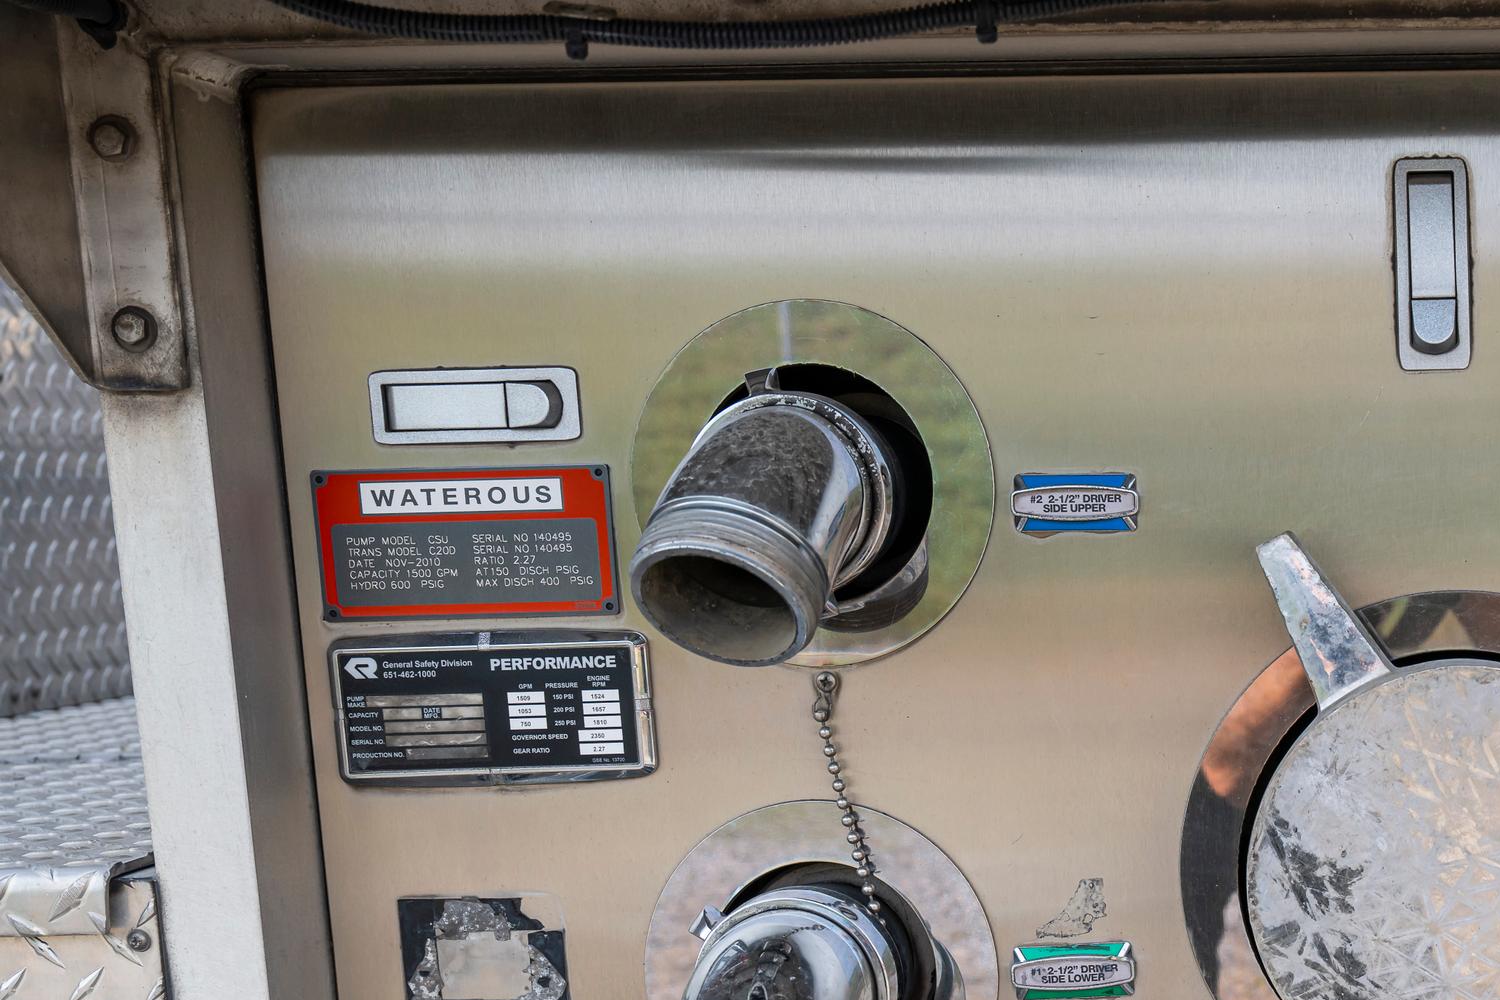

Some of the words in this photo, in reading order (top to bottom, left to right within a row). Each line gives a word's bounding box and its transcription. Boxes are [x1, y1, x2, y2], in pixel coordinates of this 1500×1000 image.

[370, 485, 552, 507] WATEROUS
[1030, 495, 1043, 503] #2
[1082, 494, 1122, 503] DRIVER
[1043, 504, 1068, 513] SIDE
[1070, 504, 1106, 513] UPPER
[346, 536, 376, 546] PUMP
[381, 535, 416, 545] MODEL
[427, 535, 449, 545] CSU
[472, 533, 508, 543] SERIAL
[513, 533, 529, 542] NO
[533, 532, 572, 542] 140495
[348, 547, 382, 557] TRANS
[387, 546, 422, 556] MODEL
[472, 544, 509, 554] SERIAL
[514, 544, 530, 553] NO
[534, 543, 573, 553] 140495
[348, 558, 376, 569] DATE
[385, 557, 441, 567] NOV-2010
[473, 555, 505, 565] RATIO
[513, 555, 536, 565] 2.27
[349, 569, 400, 580] CAPACITY
[406, 569, 432, 578] 1500
[436, 568, 459, 577] GPM
[519, 566, 550, 576] DISCH
[555, 565, 580, 574] PSIG
[350, 580, 386, 590] HYDRO
[390, 580, 411, 590] 600
[420, 579, 445, 589] PSIG
[476, 578, 498, 588] MAX
[504, 577, 535, 587] DISCH
[540, 576, 560, 586] 400
[569, 576, 594, 585] PSIG
[382, 660, 413, 669] General
[414, 660, 439, 670] Safety
[440, 659, 473, 668] Division
[490, 655, 617, 672] PERFORMANCE
[383, 670, 437, 679] 651-462-1000
[1031, 967, 1042, 976] #1
[1080, 963, 1118, 974] DRIVER
[1041, 975, 1066, 984] SIDE
[1067, 972, 1105, 983] LOWER
